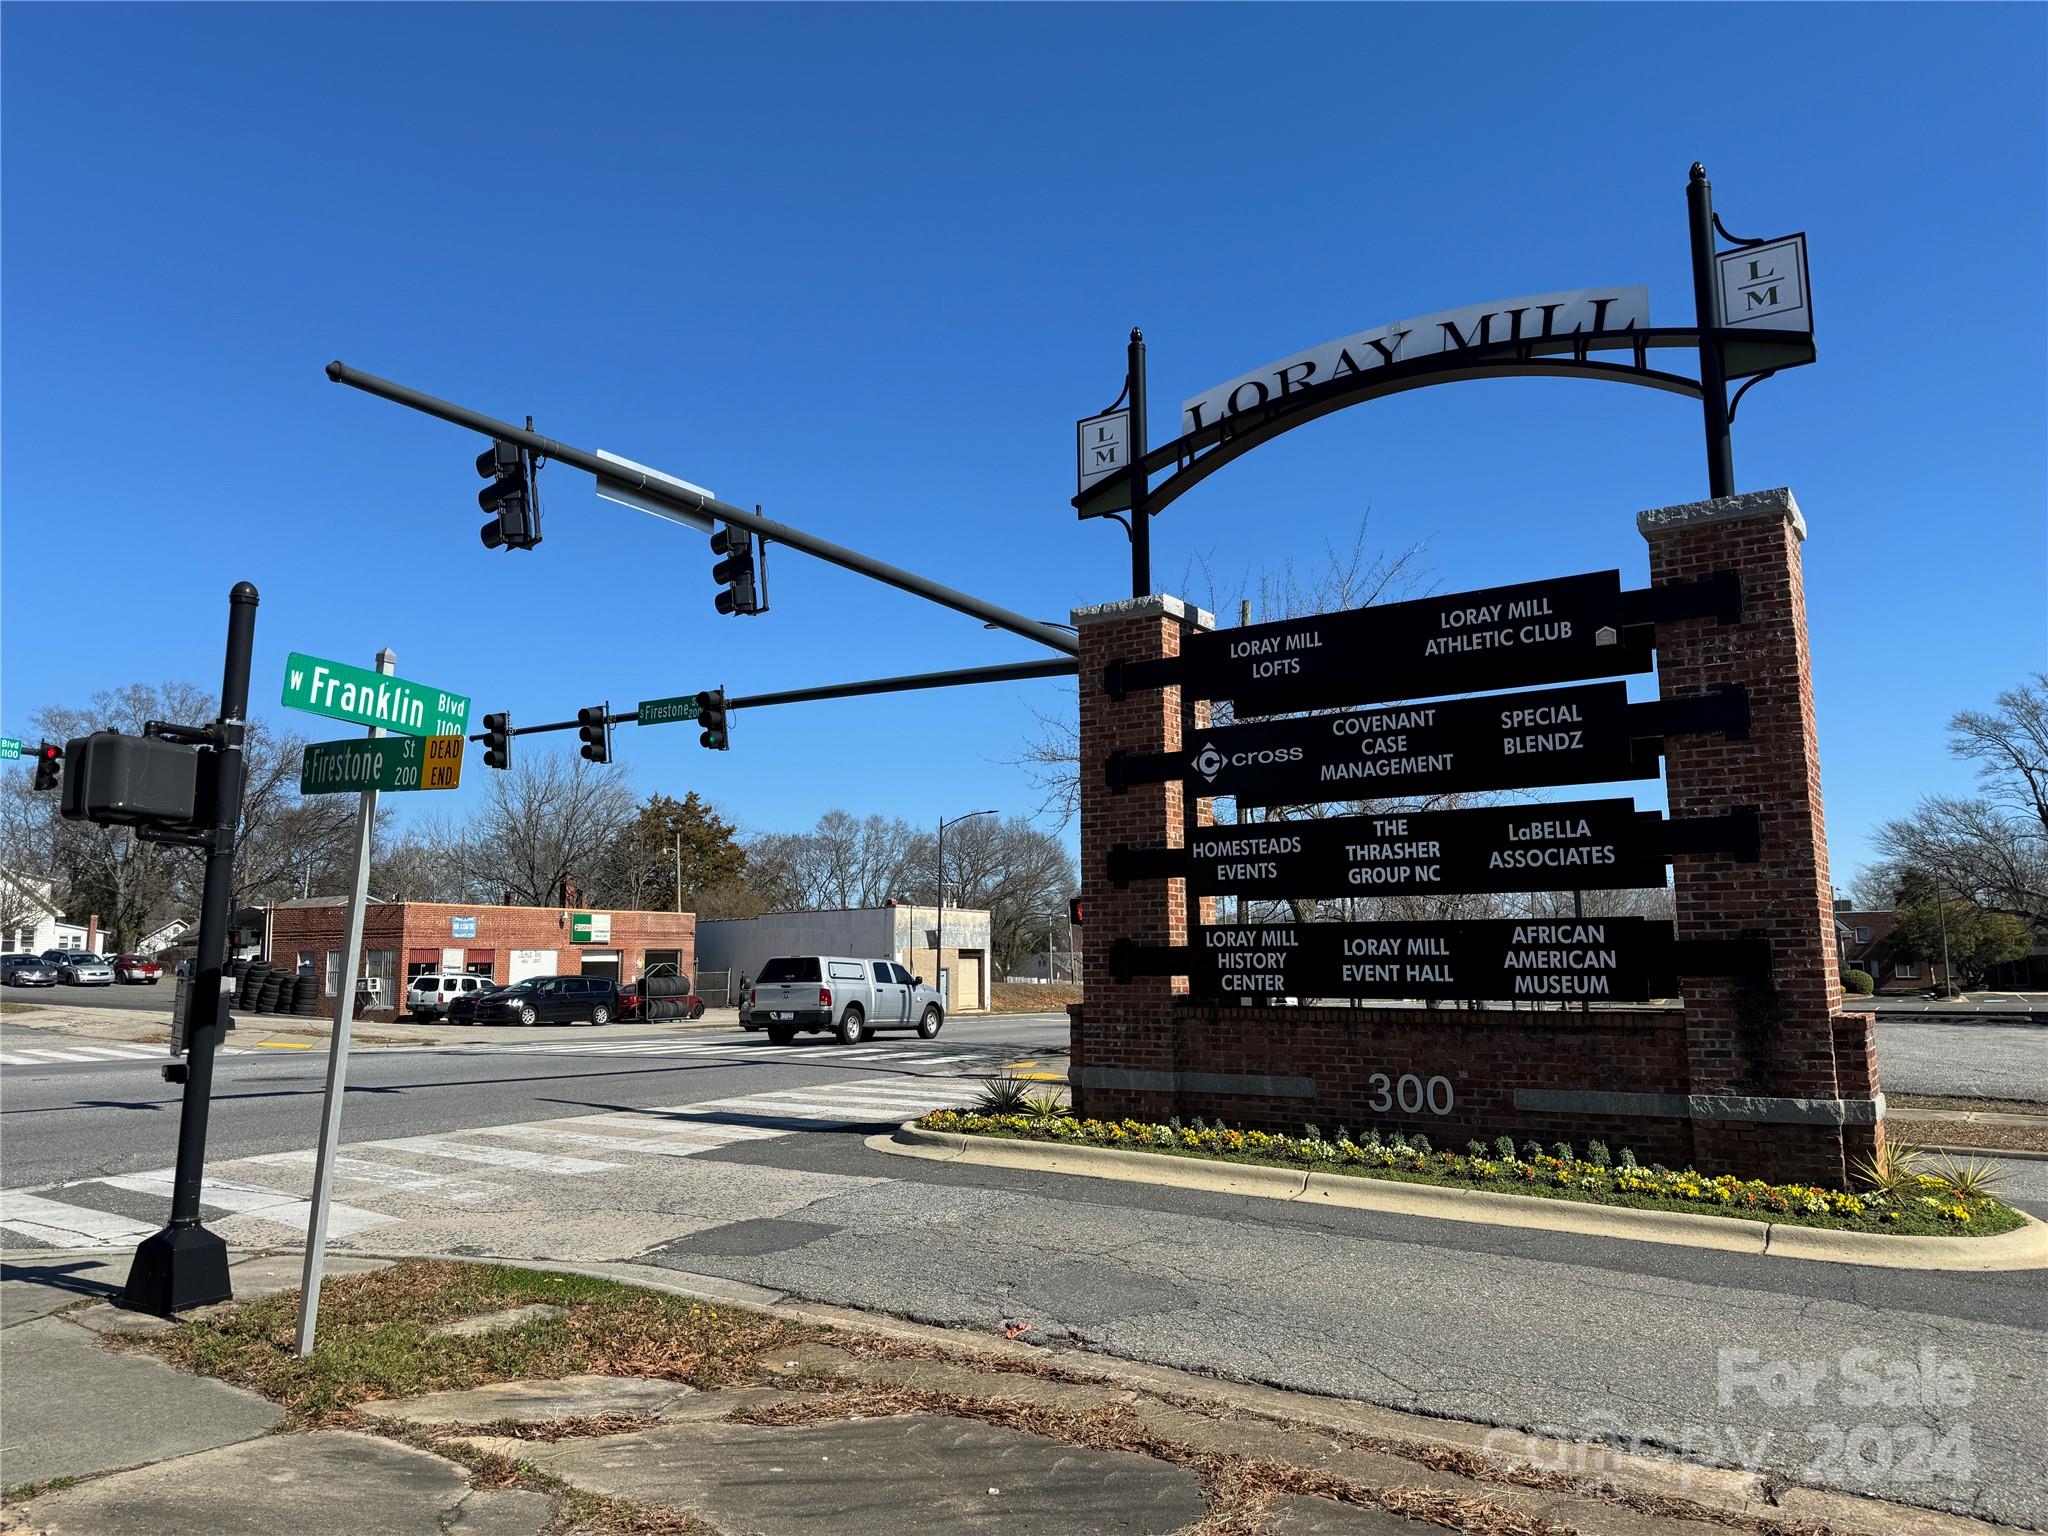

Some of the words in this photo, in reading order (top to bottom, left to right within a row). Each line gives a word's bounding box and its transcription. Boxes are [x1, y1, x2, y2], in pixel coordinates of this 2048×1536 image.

[1747, 260, 1775, 281] L
[1744, 285, 1779, 311] M
[1184, 329, 1414, 438] LORAY
[1436, 297, 1636, 352] MILL
[1098, 427, 1114, 442] L
[1096, 447, 1116, 466] M
[1441, 604, 1502, 630] LORAY
[1508, 597, 1553, 620] MILL
[1230, 637, 1281, 660] LORAY
[1286, 631, 1322, 651] MILL
[1424, 629, 1513, 657] ATHLETIC
[1519, 620, 1572, 643] CLUB
[1252, 657, 1300, 679] LOFTS
[290, 669, 304, 691] W
[310, 666, 424, 728] Franklin
[437, 694, 465, 717] Blvd
[645, 704, 689, 720] Firestone
[1500, 704, 1583, 729] SPECIAL
[436, 719, 461, 736] 1100
[1332, 708, 1436, 737] COVENANT
[1, 739, 19, 749] Blvd
[430, 740, 460, 759] DEAD
[1361, 735, 1407, 755] CASE
[1503, 730, 1584, 755] BLENDZ
[1, 749, 19, 758] 1100
[311, 748, 383, 784] Firestone
[402, 740, 416, 759] St
[1231, 747, 1304, 767] cross
[394, 766, 418, 786] 200
[430, 766, 453, 786] END
[1320, 752, 1454, 782] MANAGEMENT
[1372, 819, 1409, 837] THE
[1508, 819, 1592, 841] LaBELLA
[1192, 836, 1302, 858] HOMESTEADS
[1345, 840, 1441, 862] THRASHER
[1489, 845, 1616, 869] ASSOCIATES
[1217, 862, 1278, 881] EVENTS
[1348, 866, 1411, 885] GROUP
[1414, 864, 1441, 882] NC
[1206, 930, 1257, 948] LORAY
[1261, 930, 1299, 947] MILL
[1511, 924, 1605, 944] AFRICAN
[1343, 938, 1402, 956] LORAY
[1407, 937, 1450, 956] MILL
[1218, 952, 1287, 969] HISTORY
[1503, 950, 1617, 969] AMERICAN
[1221, 974, 1285, 991] CENTER
[1342, 964, 1401, 982] EVENT
[1406, 964, 1454, 982] HALL
[1514, 975, 1610, 994] MUSEUM
[1368, 1073, 1454, 1115] 300
